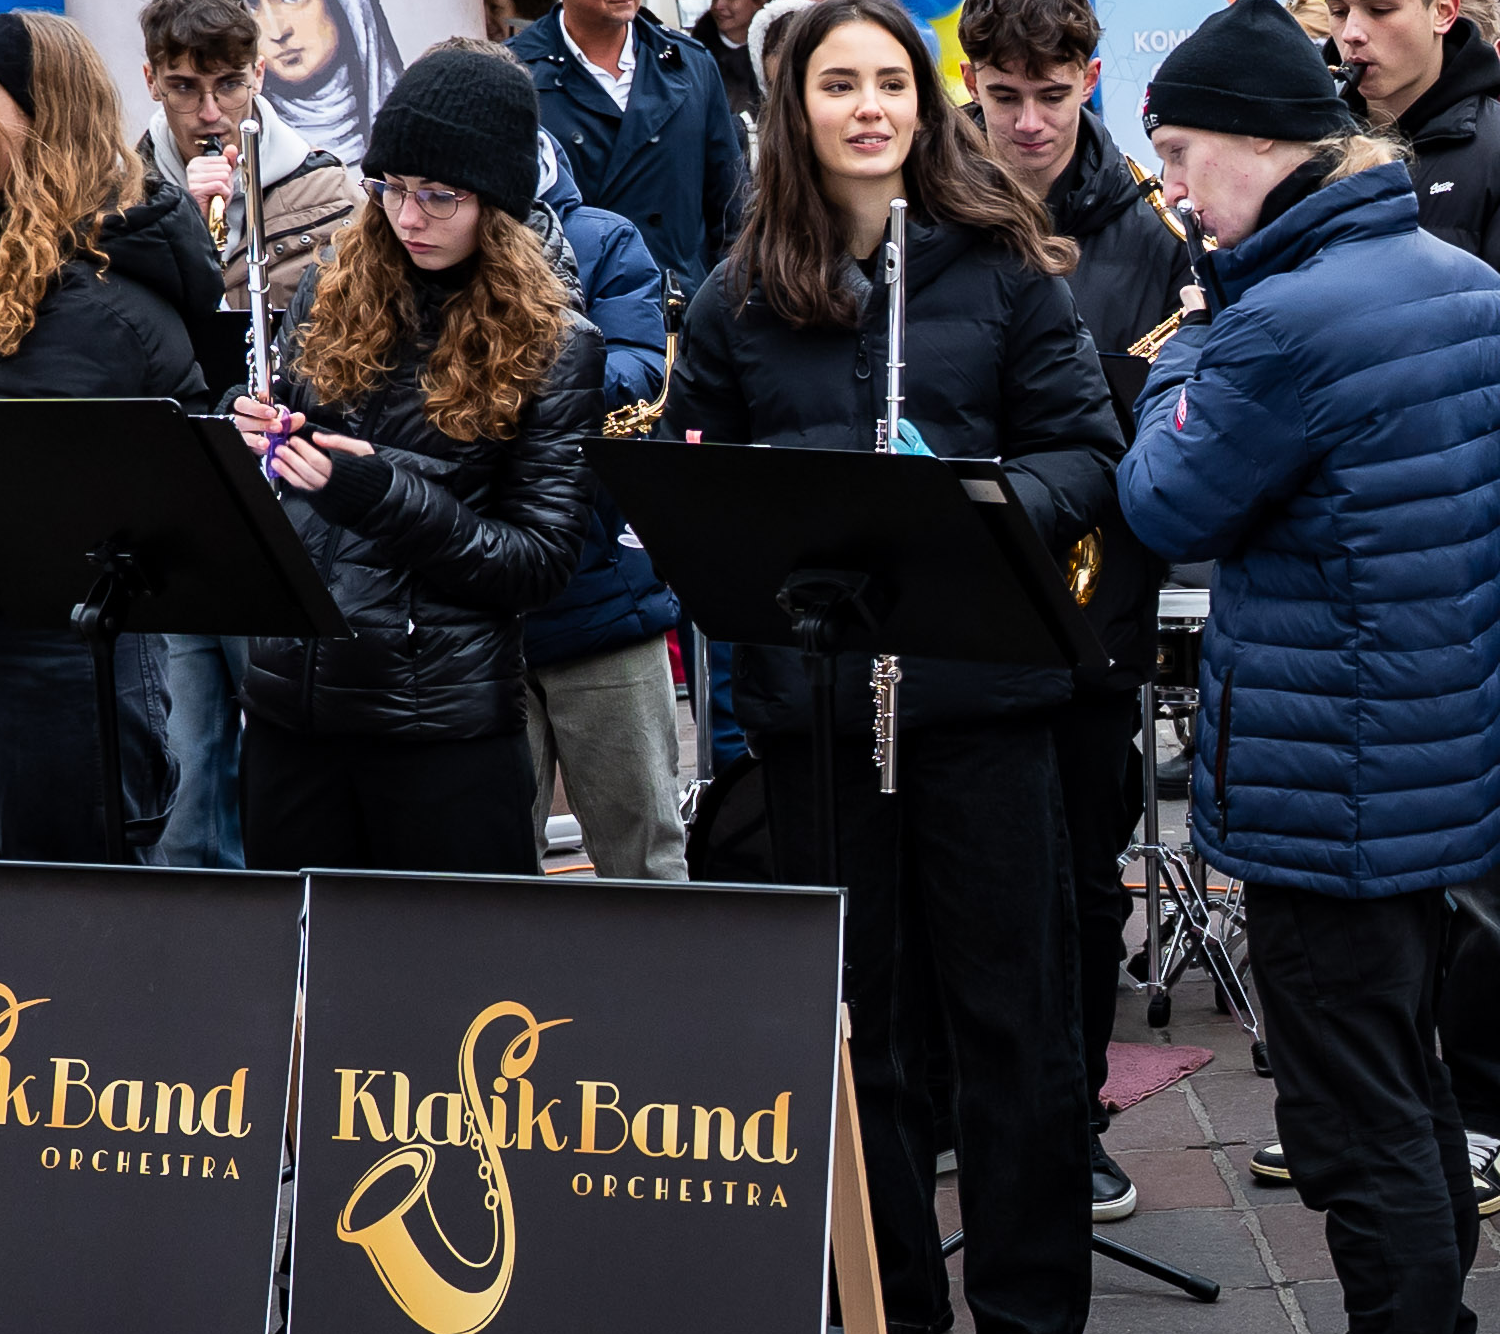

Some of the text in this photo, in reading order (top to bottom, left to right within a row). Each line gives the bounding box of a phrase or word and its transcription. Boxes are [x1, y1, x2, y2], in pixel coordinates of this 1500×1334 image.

[1133, 29, 1195, 53] KOM
[44, 1057, 252, 1139] Band
[573, 1080, 798, 1165] Band
[41, 1146, 240, 1180] ORCHESTRA
[572, 1173, 788, 1208] ORCHESTRA
